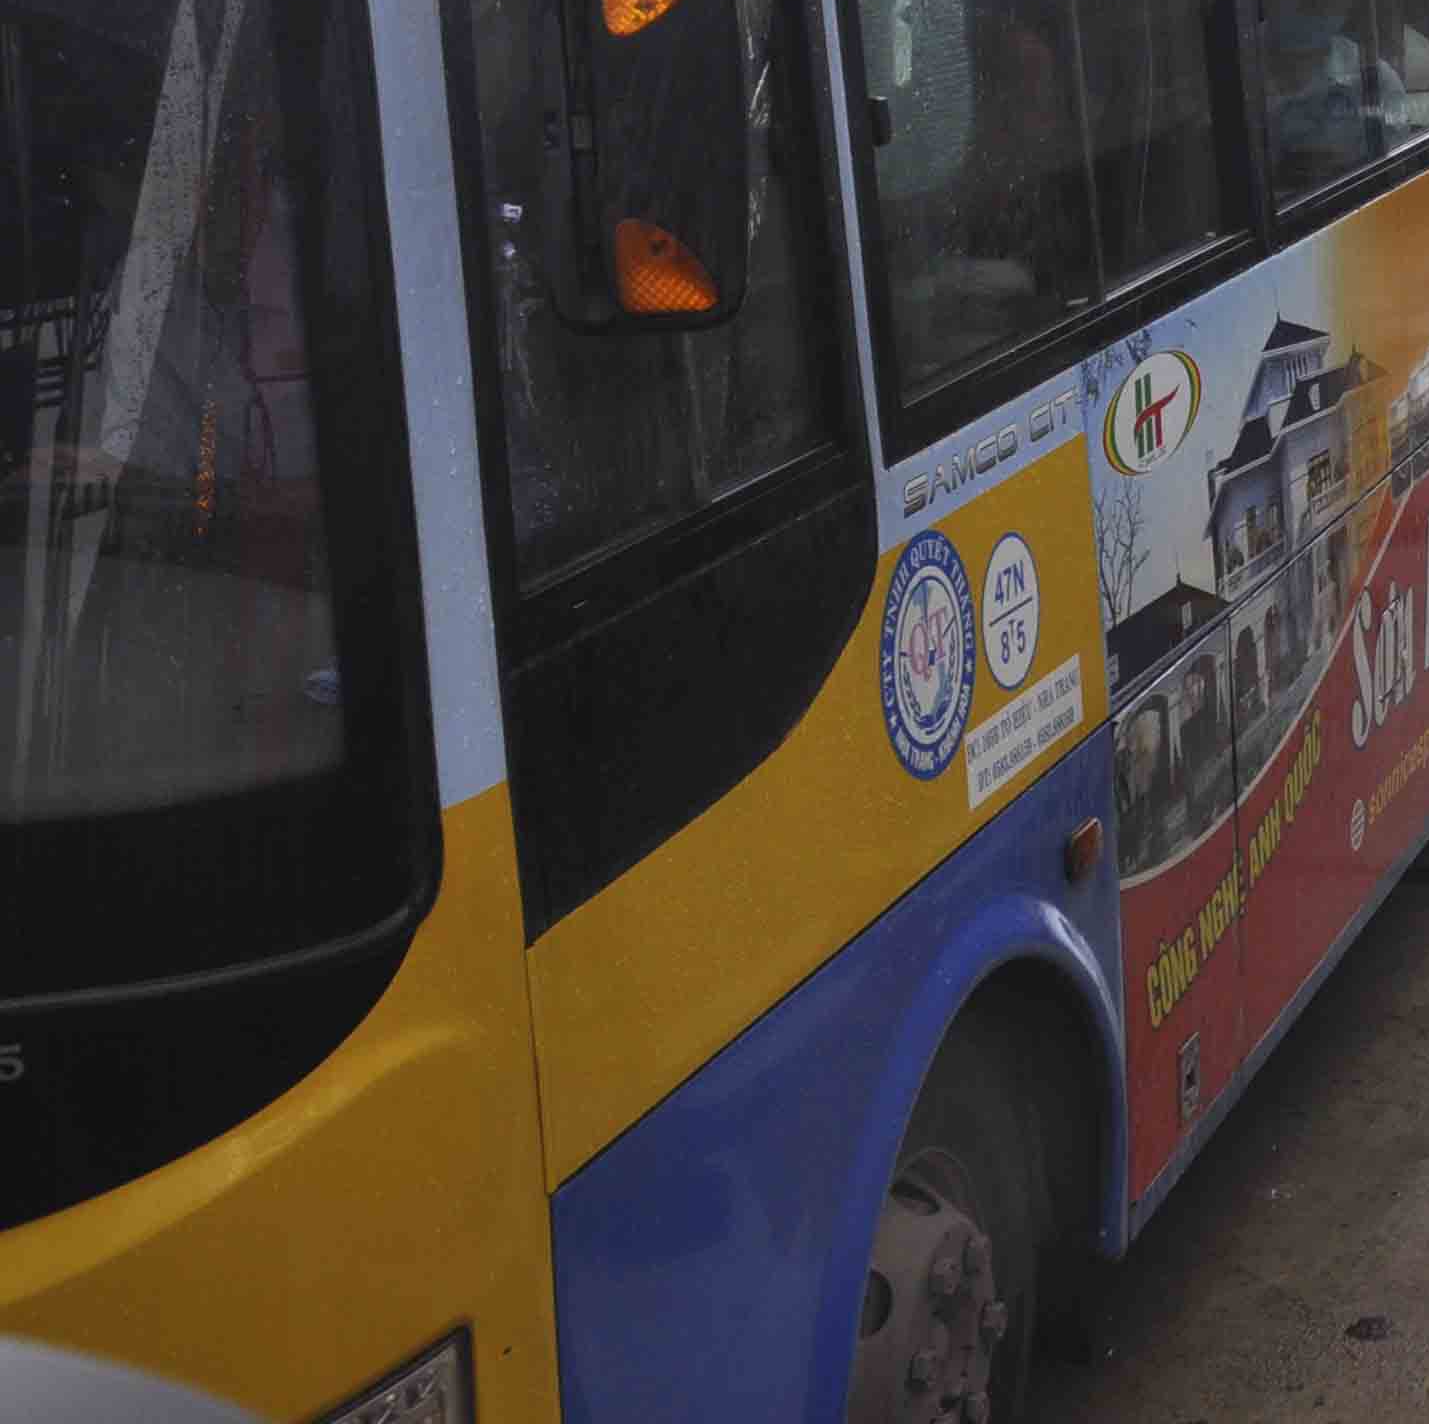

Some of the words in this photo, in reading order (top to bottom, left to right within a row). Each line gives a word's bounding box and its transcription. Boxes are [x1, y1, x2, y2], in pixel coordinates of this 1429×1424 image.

[904, 423, 1019, 519] SAMCO
[1029, 384, 1076, 443] CIT
[993, 558, 1026, 604] 47N
[1145, 927, 1198, 1029] CÔNG
